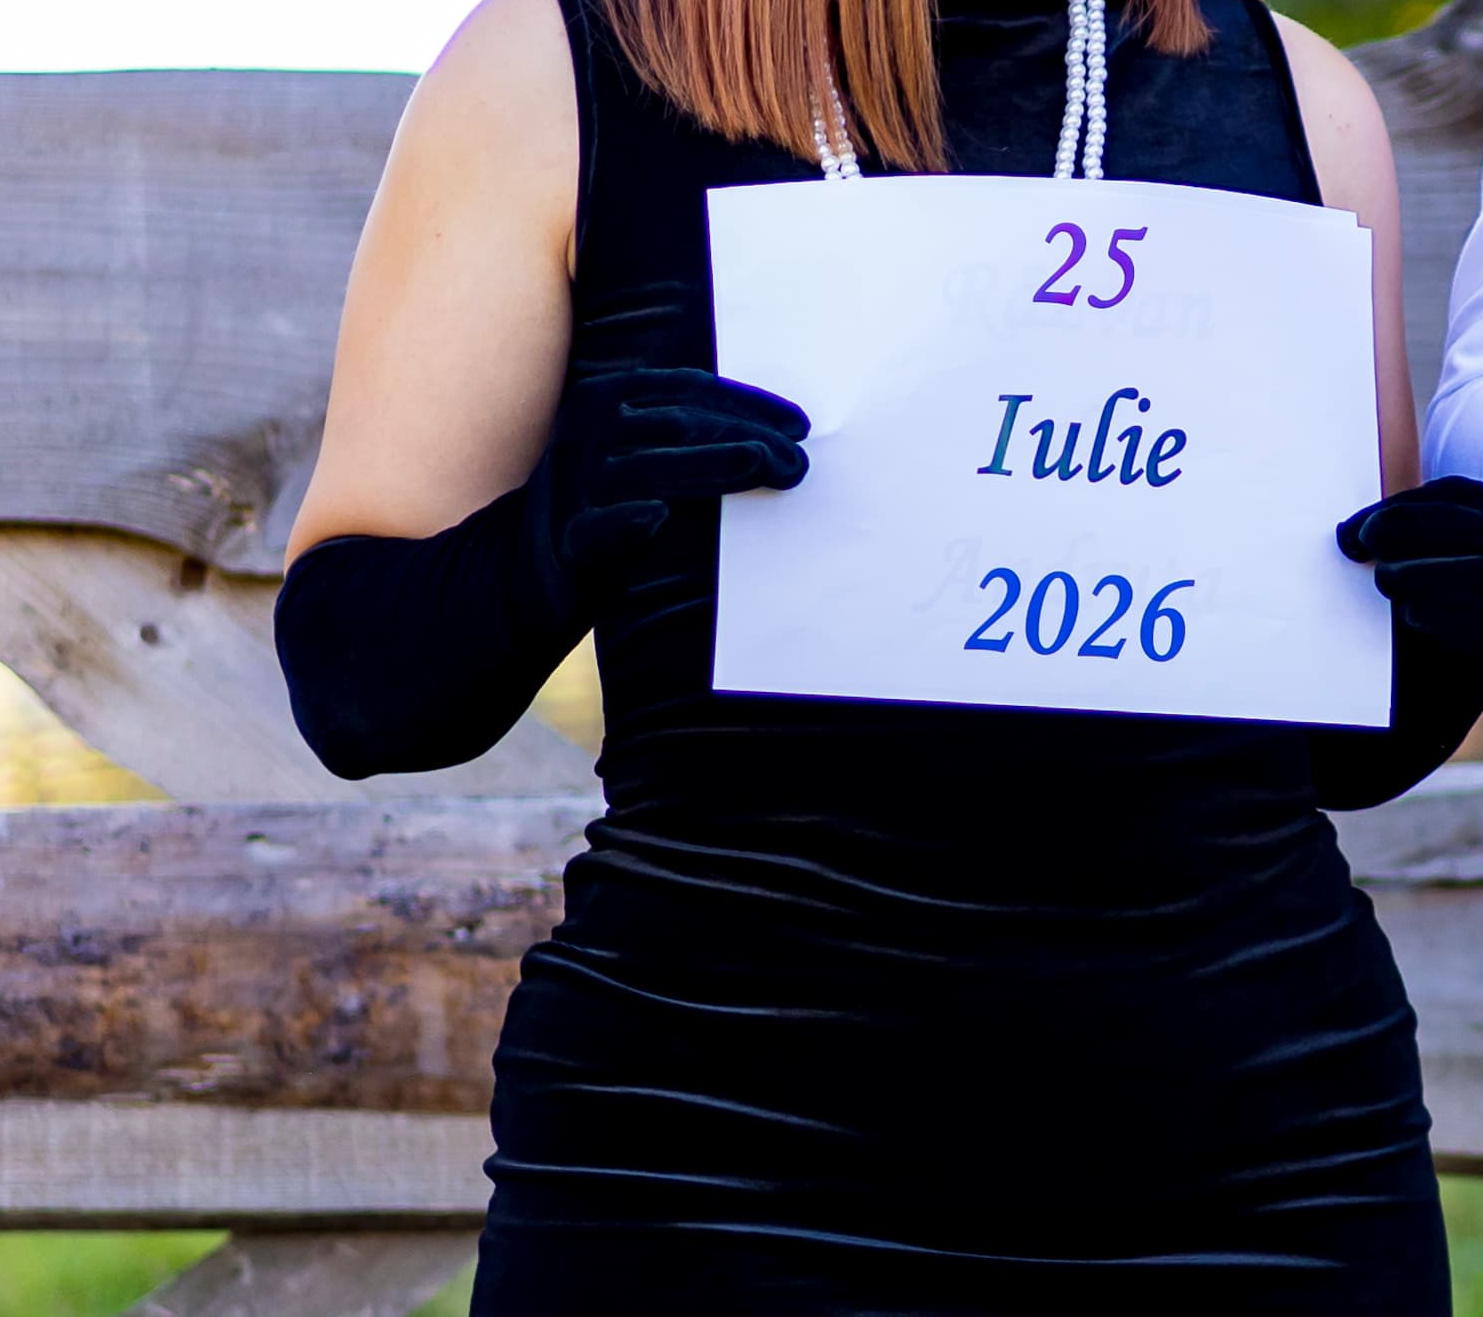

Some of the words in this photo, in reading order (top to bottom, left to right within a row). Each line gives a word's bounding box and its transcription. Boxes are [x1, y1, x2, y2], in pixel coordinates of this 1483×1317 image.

[1033, 222, 1148, 309] 25
[977, 388, 1187, 487] Iulie
[964, 568, 1195, 662] 2026
